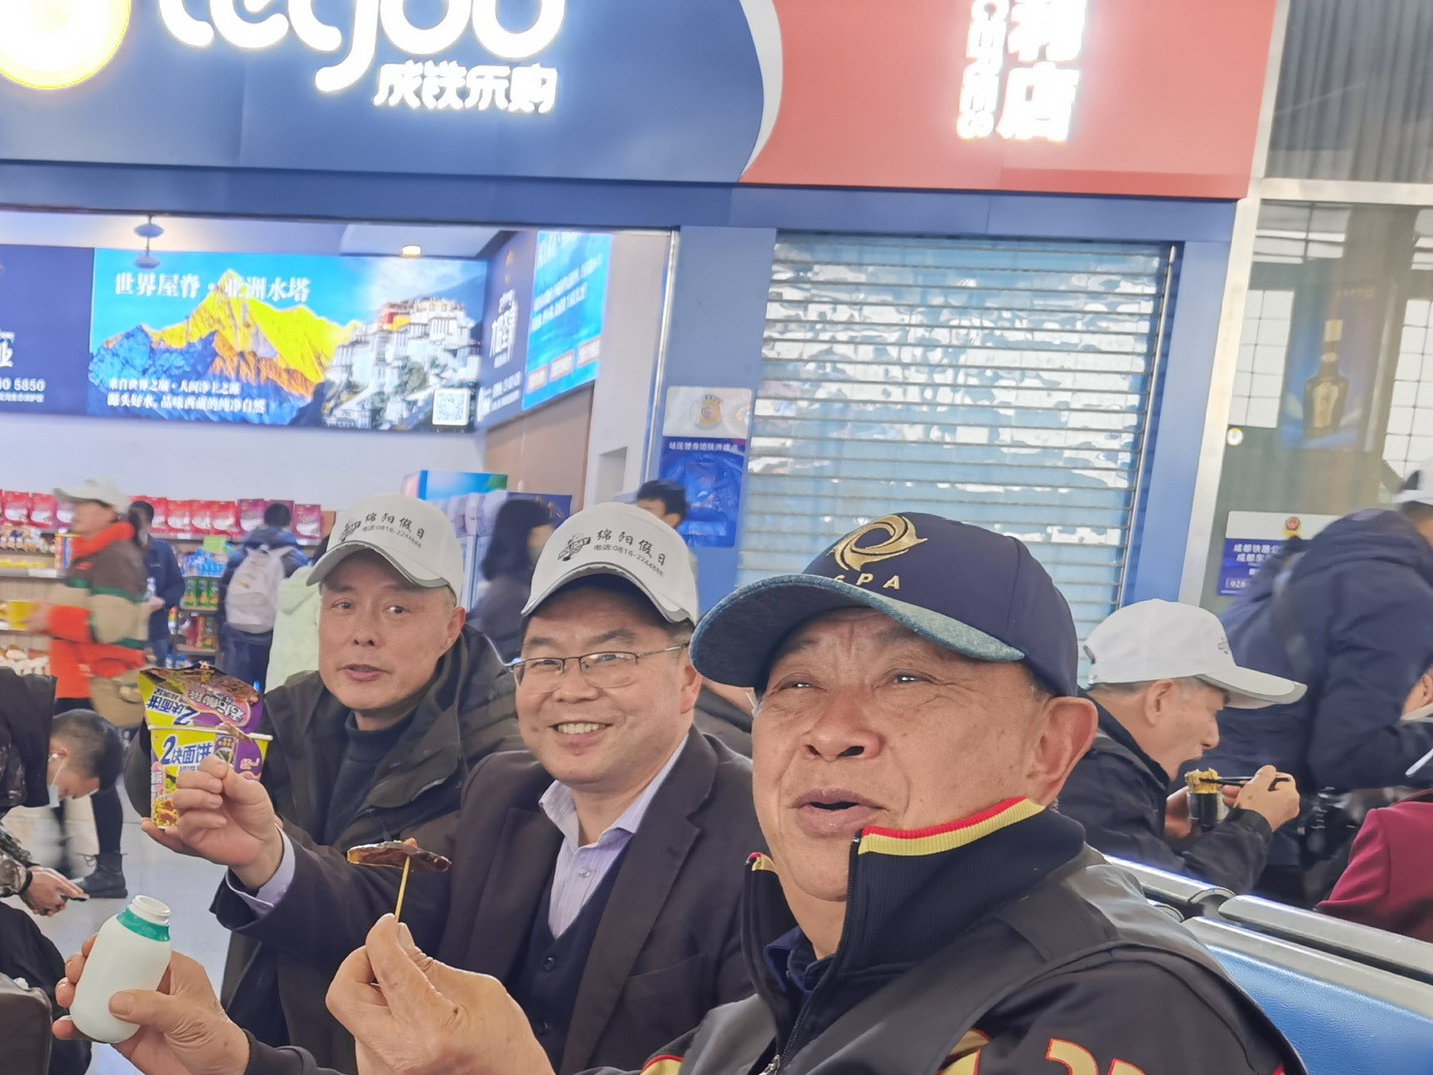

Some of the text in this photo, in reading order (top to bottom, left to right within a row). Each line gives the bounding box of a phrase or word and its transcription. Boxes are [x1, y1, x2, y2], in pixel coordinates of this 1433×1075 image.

[373, 60, 558, 113] 成铁乐购
[14, 378, 46, 392] 5850
[160, 735, 215, 765] 2块面饼
